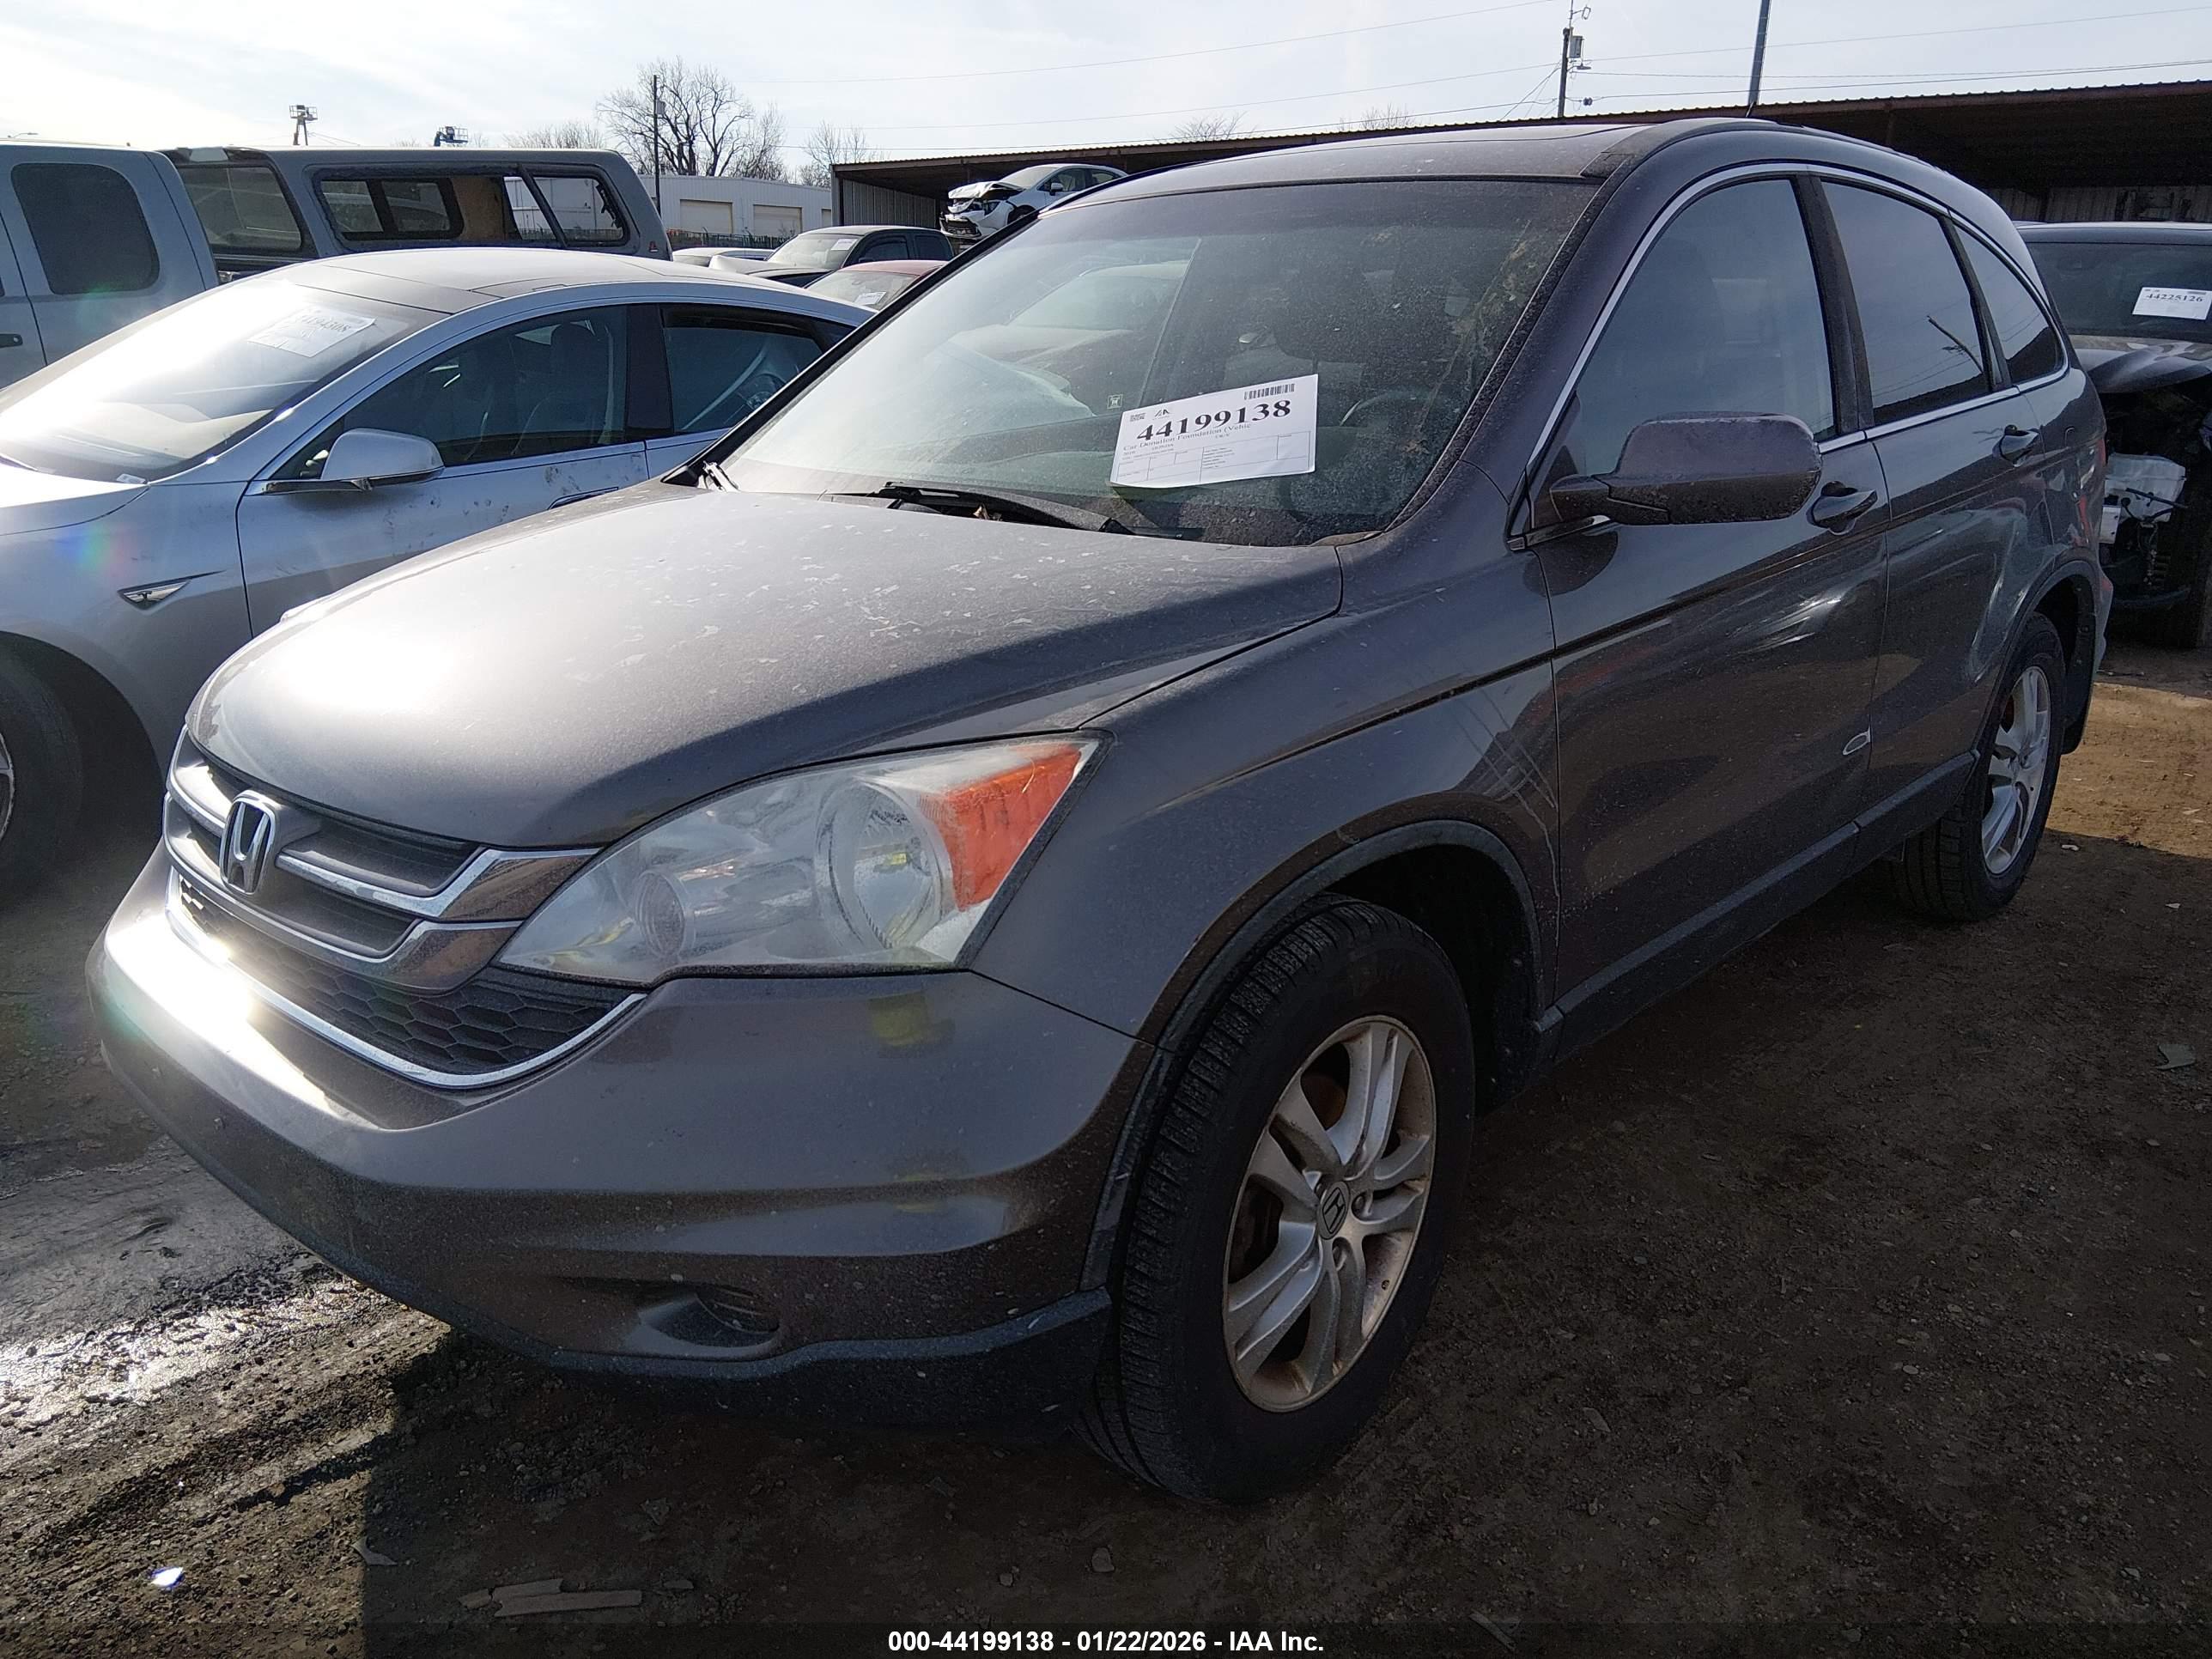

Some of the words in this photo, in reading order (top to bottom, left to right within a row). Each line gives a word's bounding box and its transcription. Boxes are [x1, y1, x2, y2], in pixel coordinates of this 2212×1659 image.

[2145, 294, 2203, 302] 44225126
[1136, 398, 1291, 441] 44199138
[1139, 437, 1175, 447] Donation
[1177, 428, 1222, 440] Foundation
